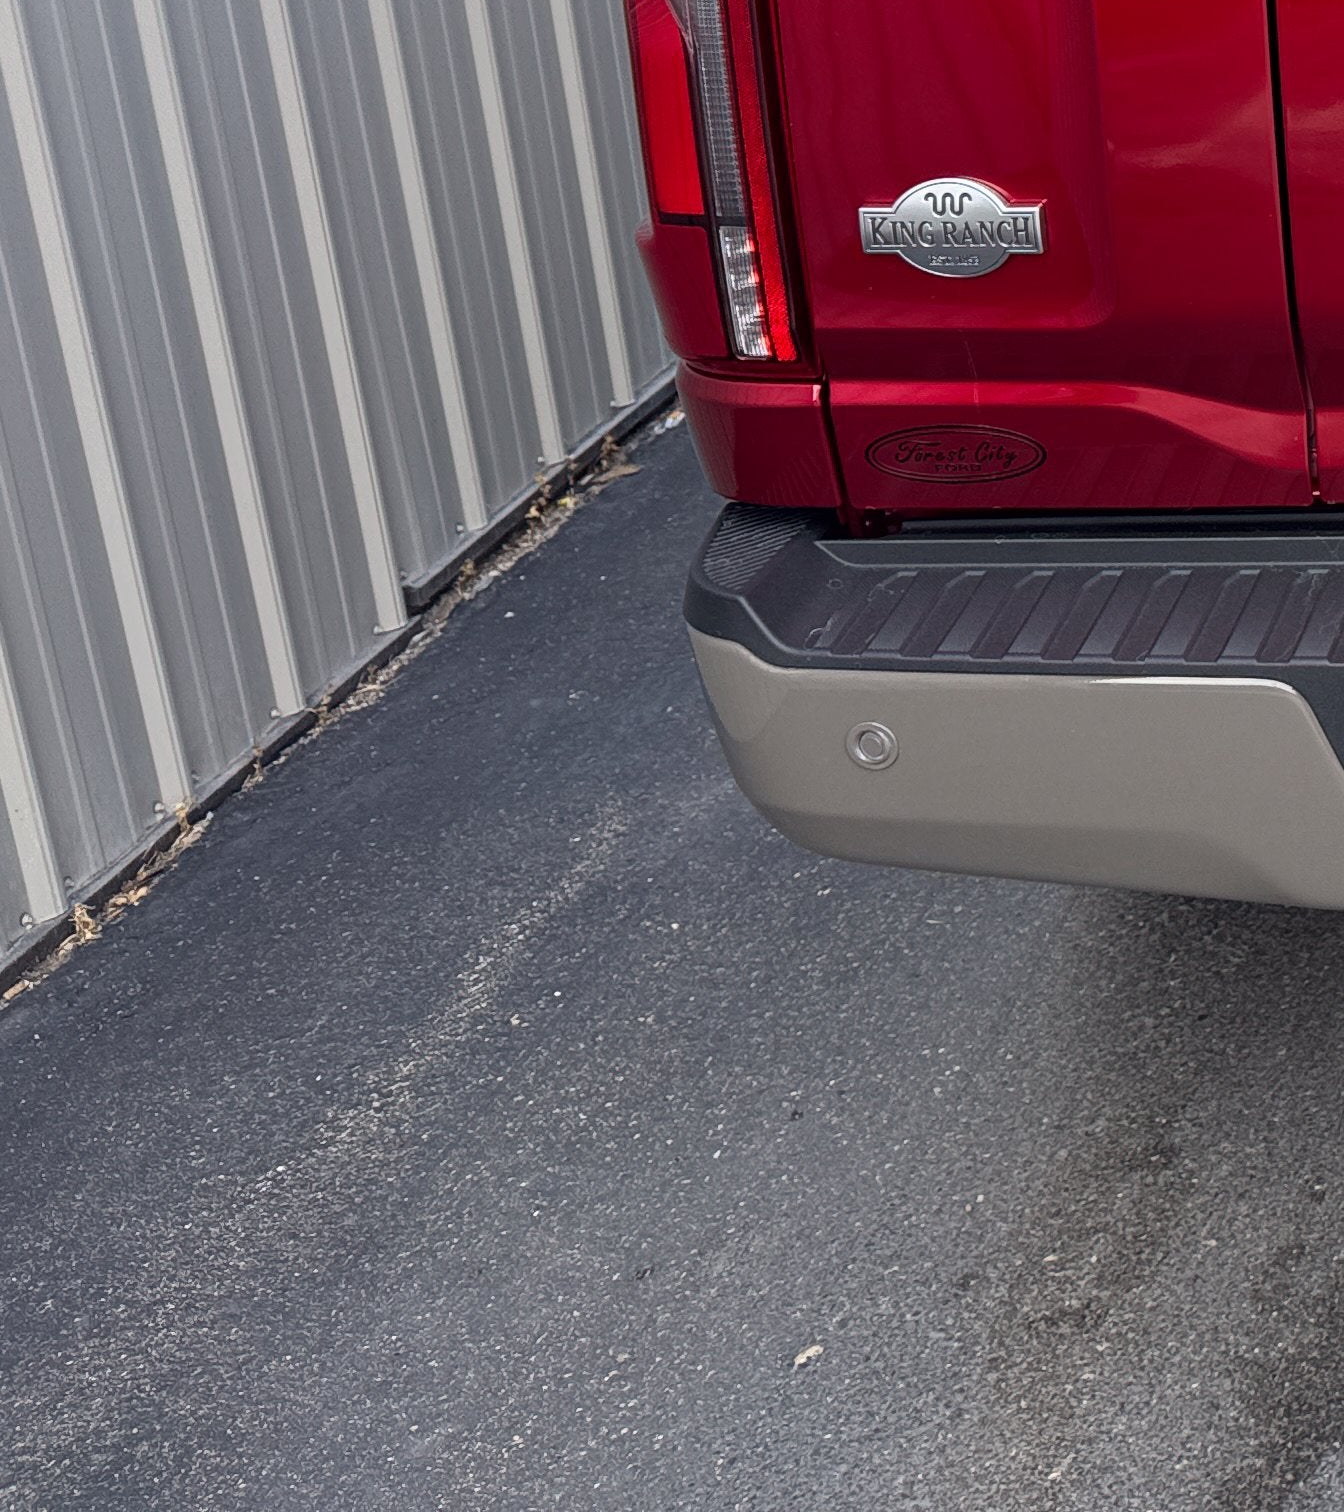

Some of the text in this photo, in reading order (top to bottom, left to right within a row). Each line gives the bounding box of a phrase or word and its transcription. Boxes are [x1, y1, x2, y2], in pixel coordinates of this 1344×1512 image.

[868, 216, 1034, 248] KING RANCH
[895, 440, 1018, 469] Forest City
